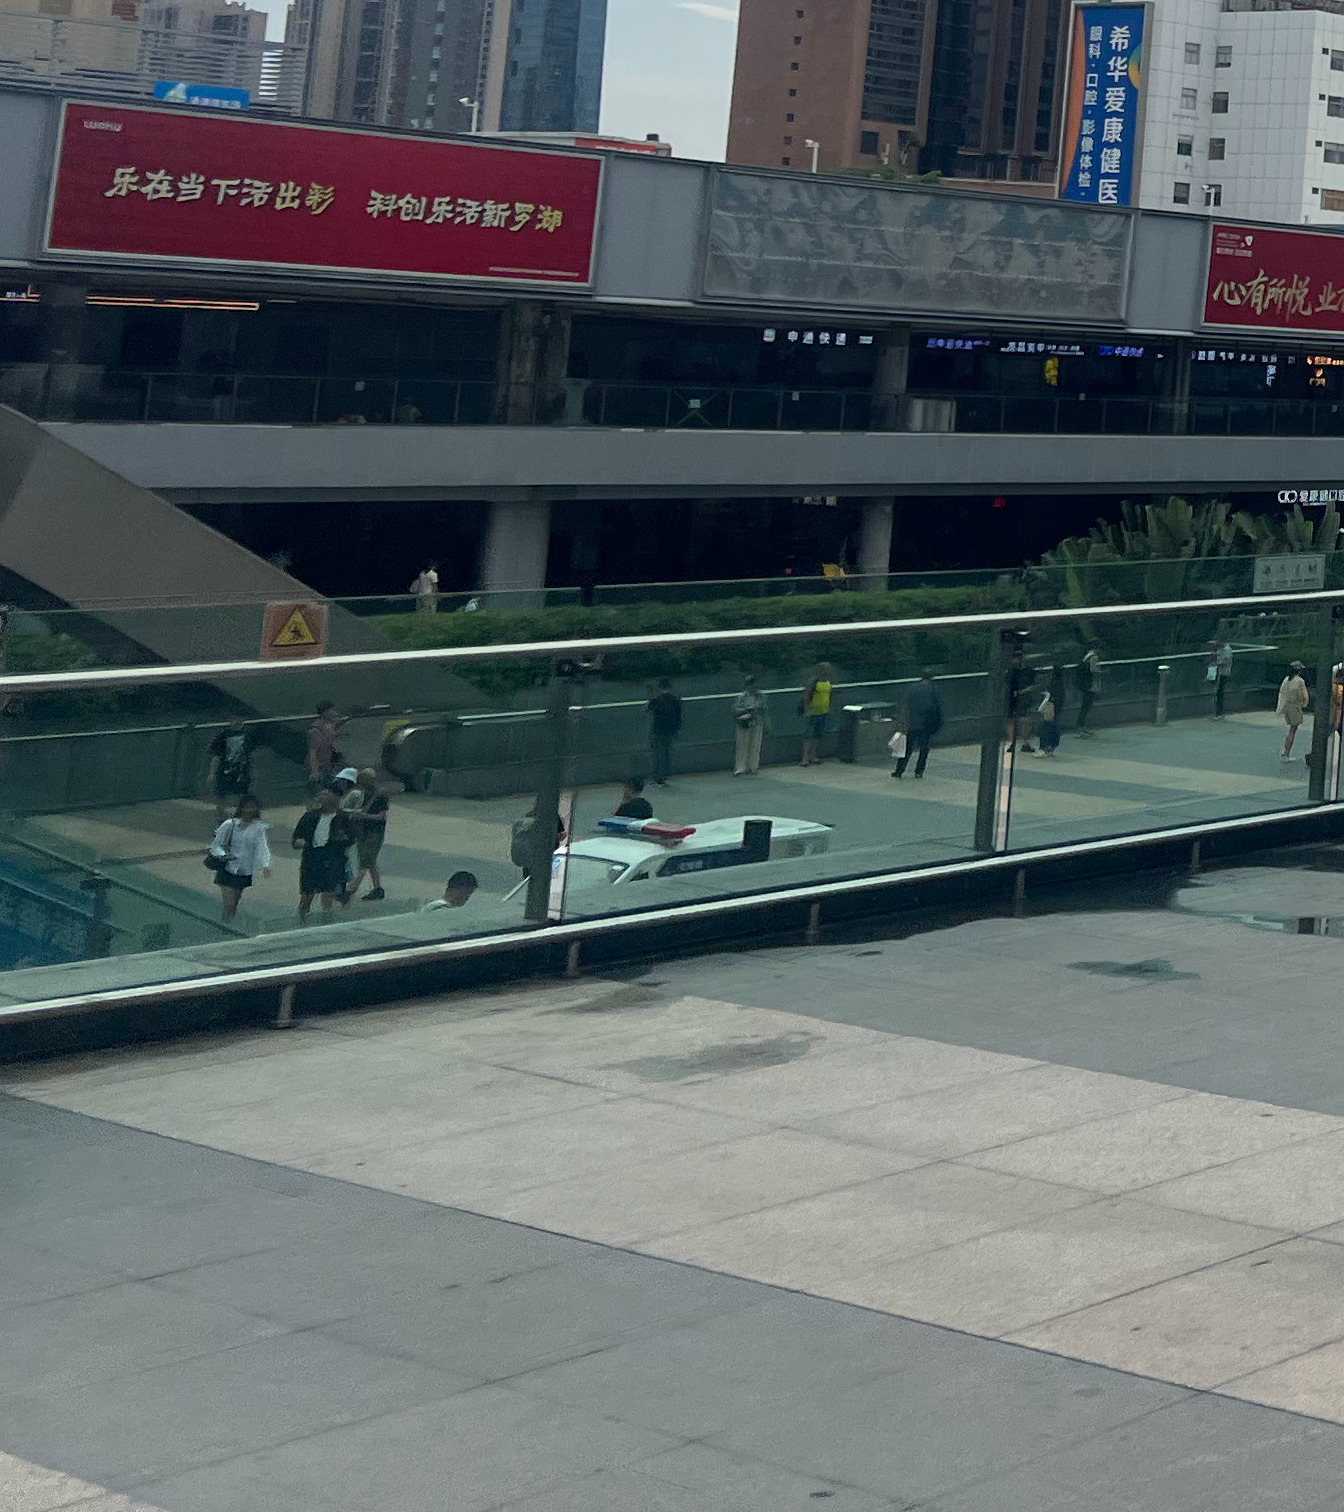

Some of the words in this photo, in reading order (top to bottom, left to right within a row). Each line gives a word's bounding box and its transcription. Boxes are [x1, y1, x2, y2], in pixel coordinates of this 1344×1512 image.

[1097, 25, 1131, 204] 希华爱康健医
[103, 166, 336, 215] 乐在当下活出彩
[366, 190, 564, 233] 科创乐活新罗湖
